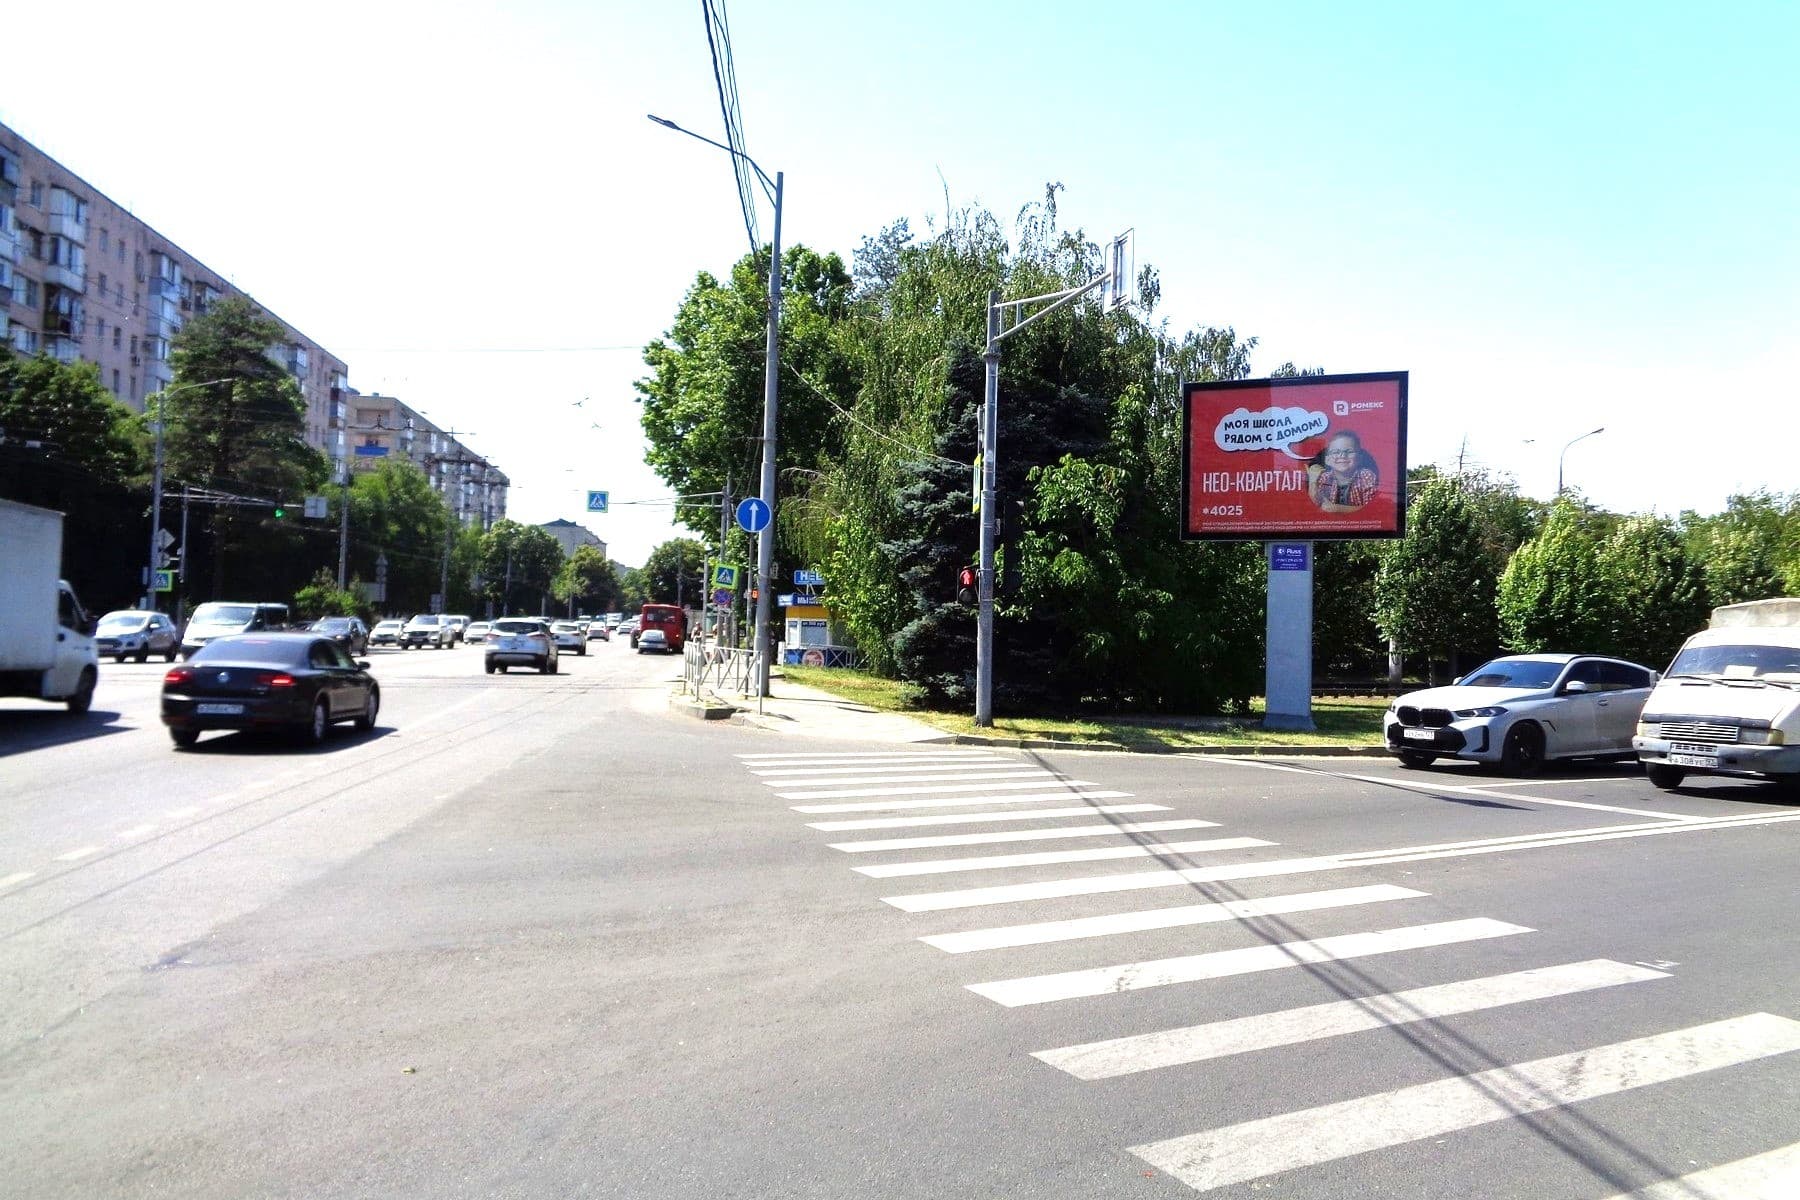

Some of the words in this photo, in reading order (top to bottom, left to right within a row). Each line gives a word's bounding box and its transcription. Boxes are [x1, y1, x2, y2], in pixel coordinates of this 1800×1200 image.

[1224, 419, 1249, 431] МОЯ
[1253, 416, 1292, 428] ШКОЛА
[1224, 433, 1262, 443] РЯДОМ
[1265, 433, 1273, 441] С
[1276, 418, 1323, 441] ДОМОМ!
[1202, 470, 1302, 493] НЕО-КВАРТАЛ
